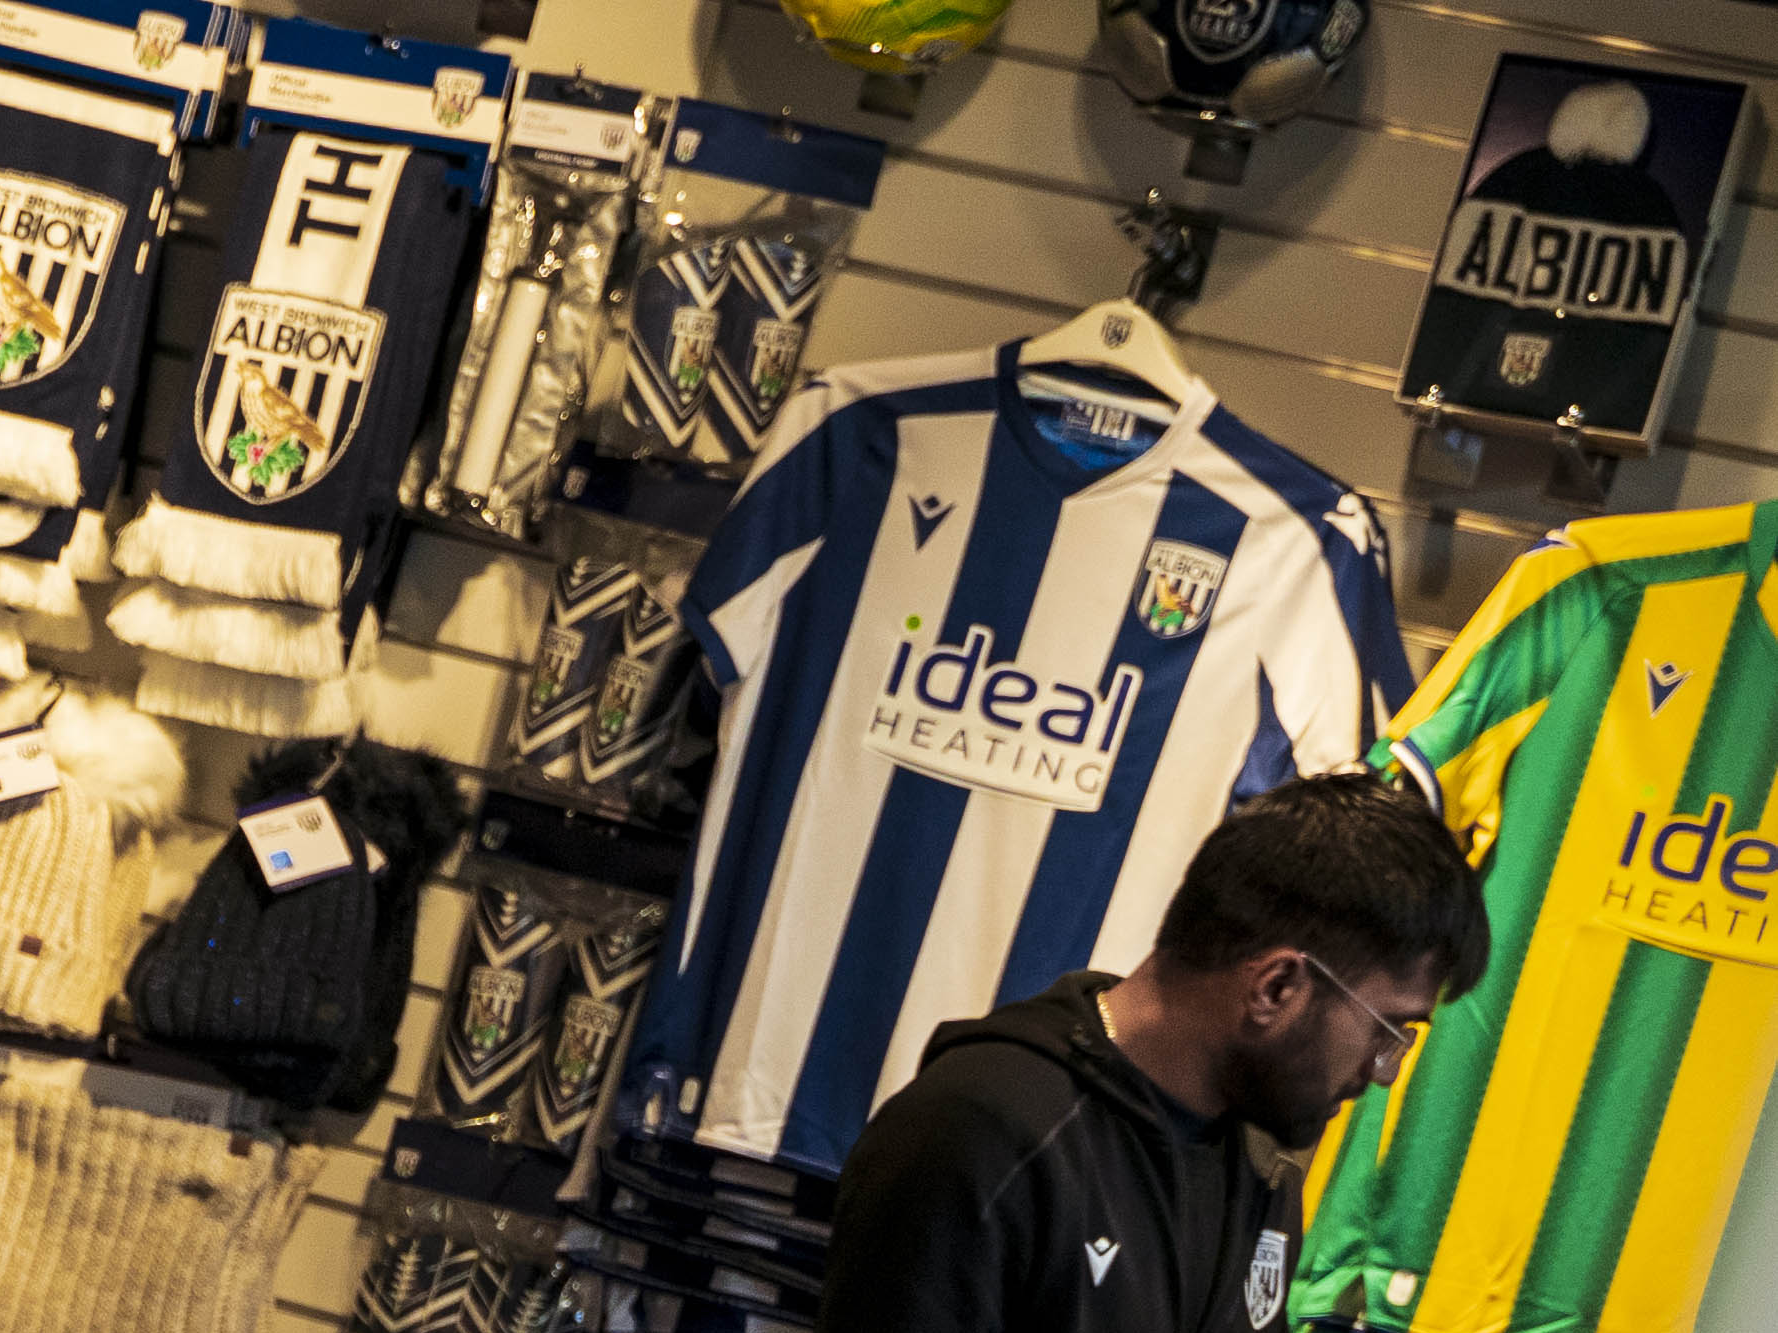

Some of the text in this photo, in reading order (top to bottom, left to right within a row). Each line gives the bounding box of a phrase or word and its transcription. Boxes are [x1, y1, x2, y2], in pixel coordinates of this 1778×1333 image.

[1455, 210, 1676, 312] ALBION
[223, 317, 363, 369] ALBION
[884, 613, 1133, 752] ideal
[869, 706, 1104, 796] HEATING
[1602, 879, 1768, 944] HEATI
